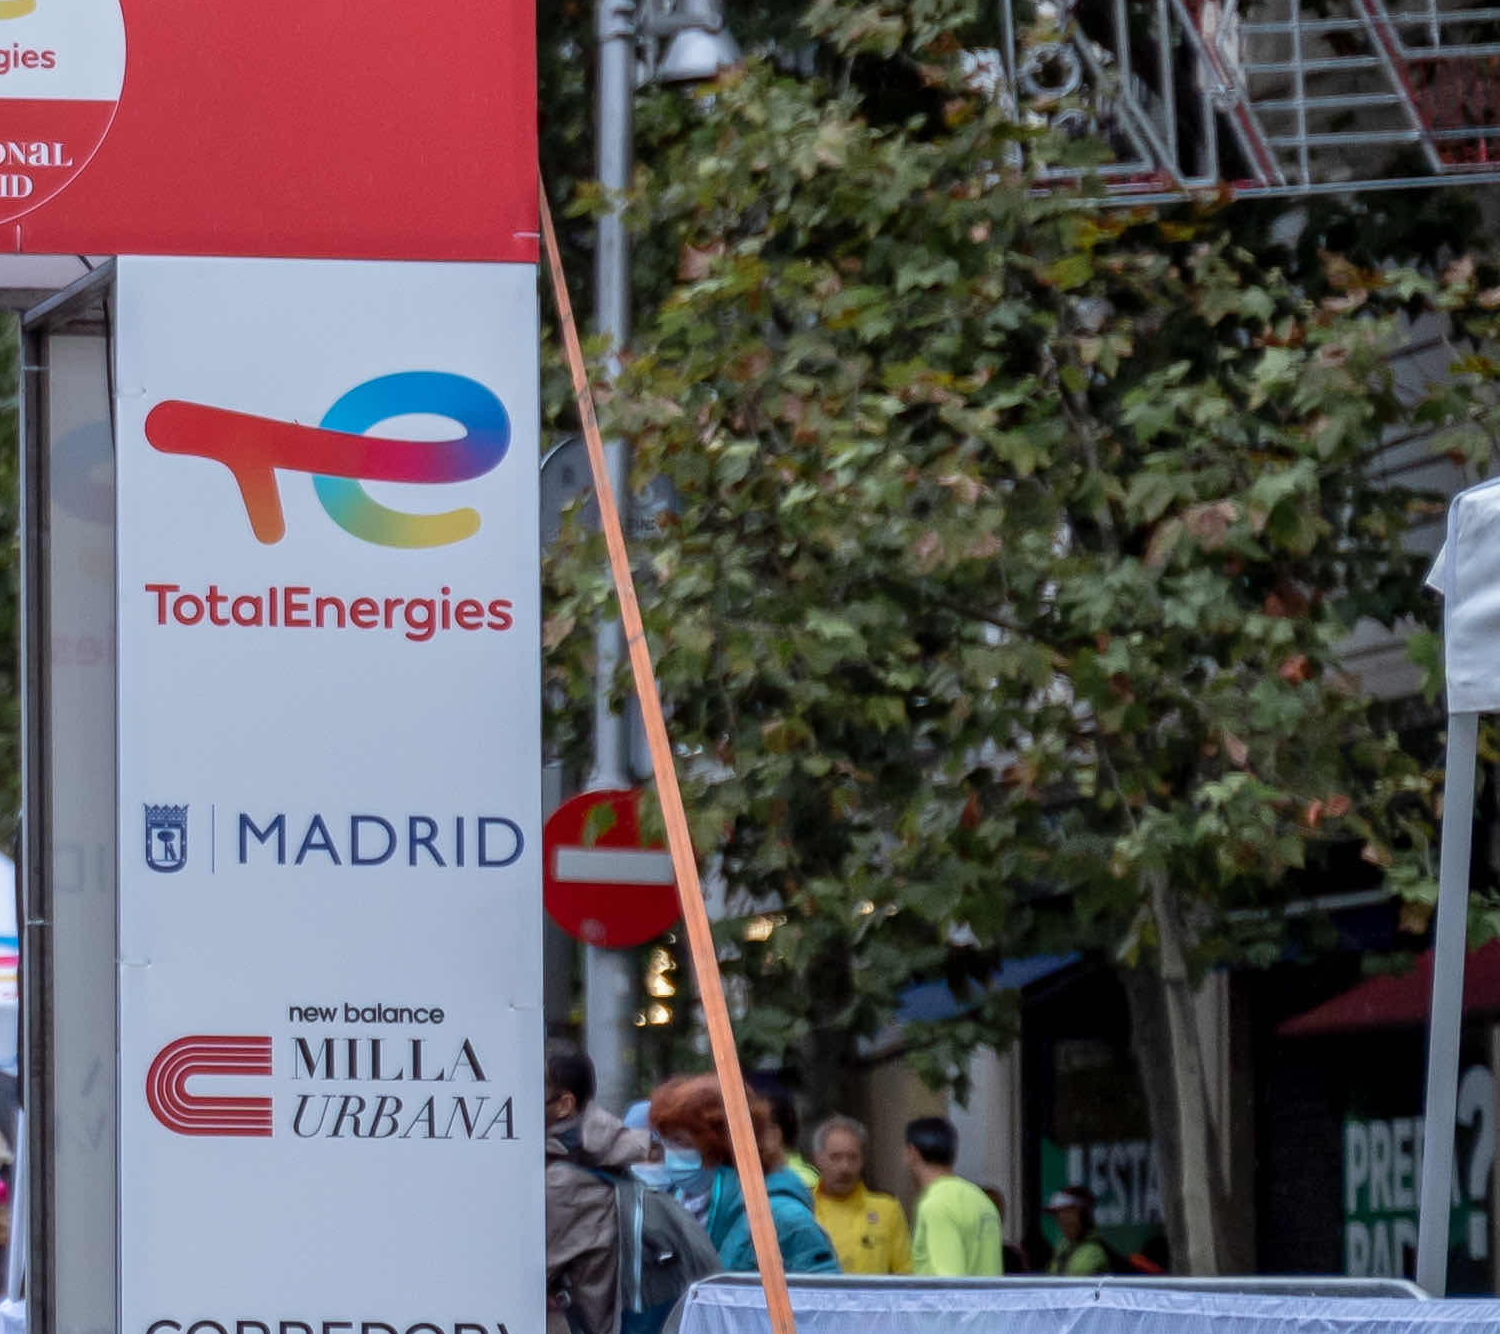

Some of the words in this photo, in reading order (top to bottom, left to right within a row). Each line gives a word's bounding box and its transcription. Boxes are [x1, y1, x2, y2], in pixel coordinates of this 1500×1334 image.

[143, 582, 514, 643] TotalEnergies
[237, 812, 526, 869] MADRID
[288, 1005, 339, 1024] new
[343, 1001, 446, 1026] balance
[294, 1036, 487, 1083] MILLA
[291, 1093, 520, 1141] URBANA
